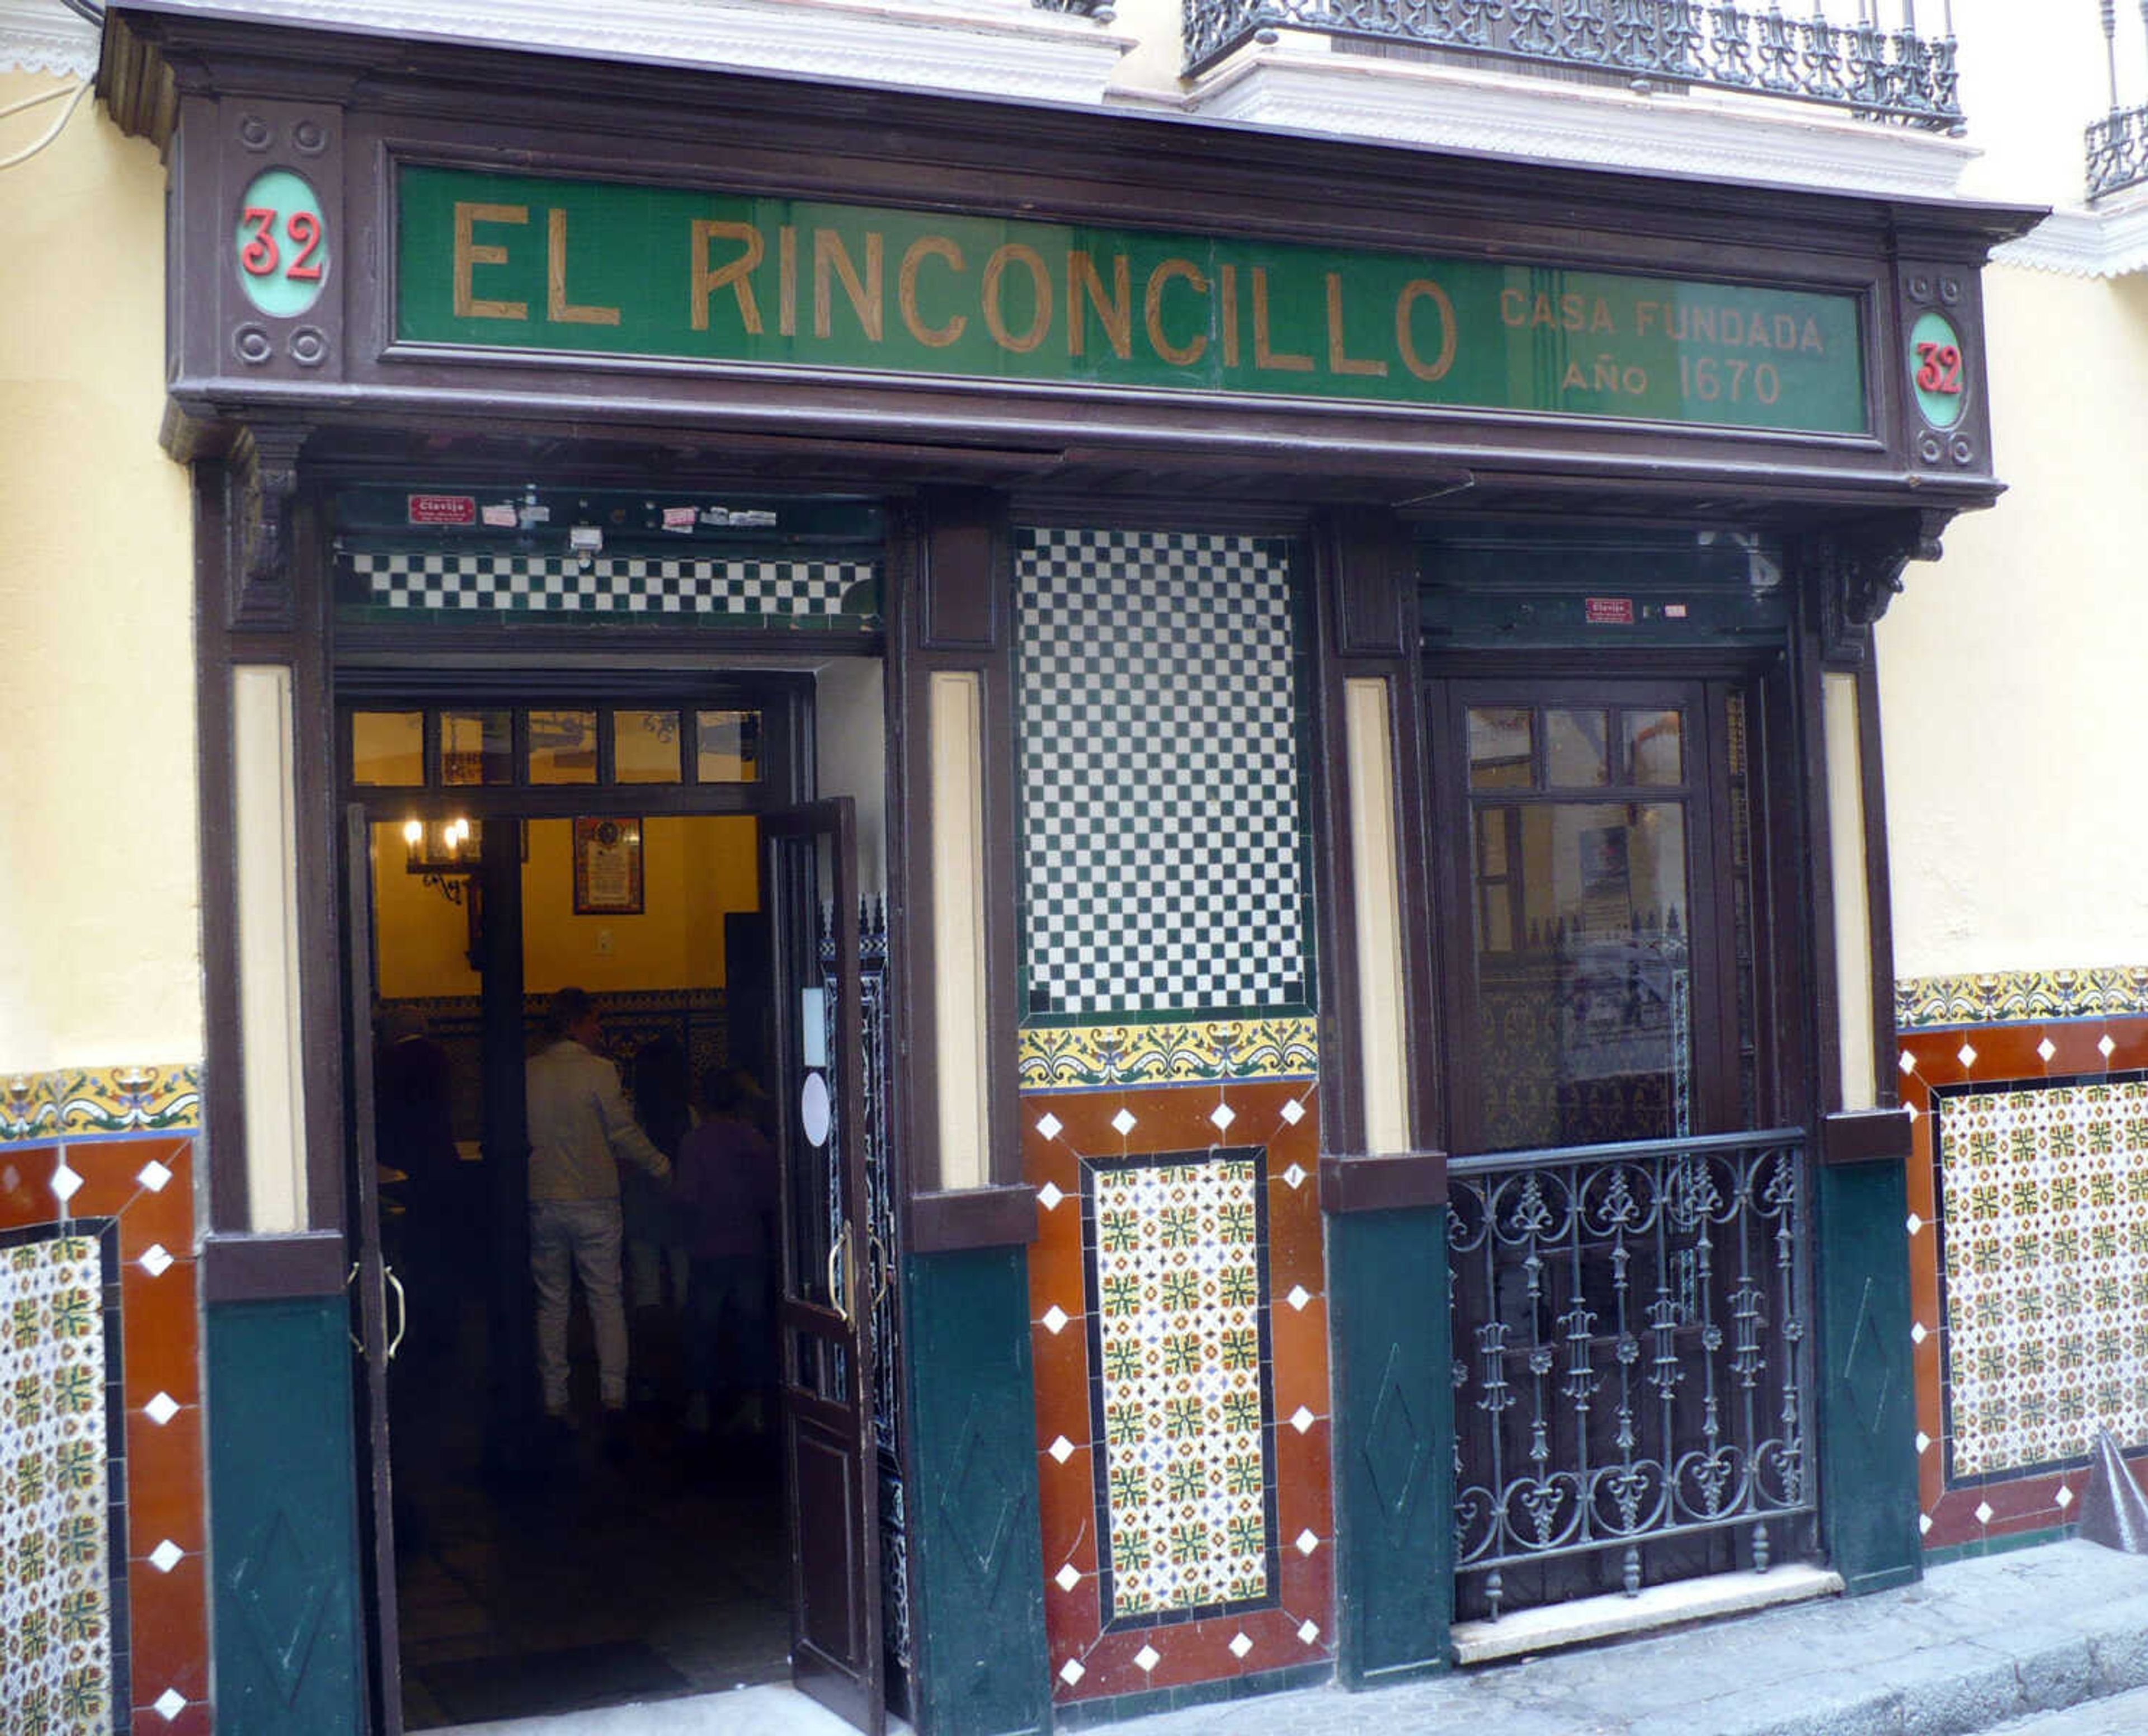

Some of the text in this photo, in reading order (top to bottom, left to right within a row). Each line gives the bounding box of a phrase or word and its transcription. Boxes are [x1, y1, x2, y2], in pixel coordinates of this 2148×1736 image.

[241, 208, 323, 280] 32
[454, 202, 1456, 382] EL RINCONCILLO
[1500, 289, 1824, 354] CASA FUNDADA
[1562, 354, 1780, 406] AÑO 1670
[1915, 342, 1962, 394] 32
